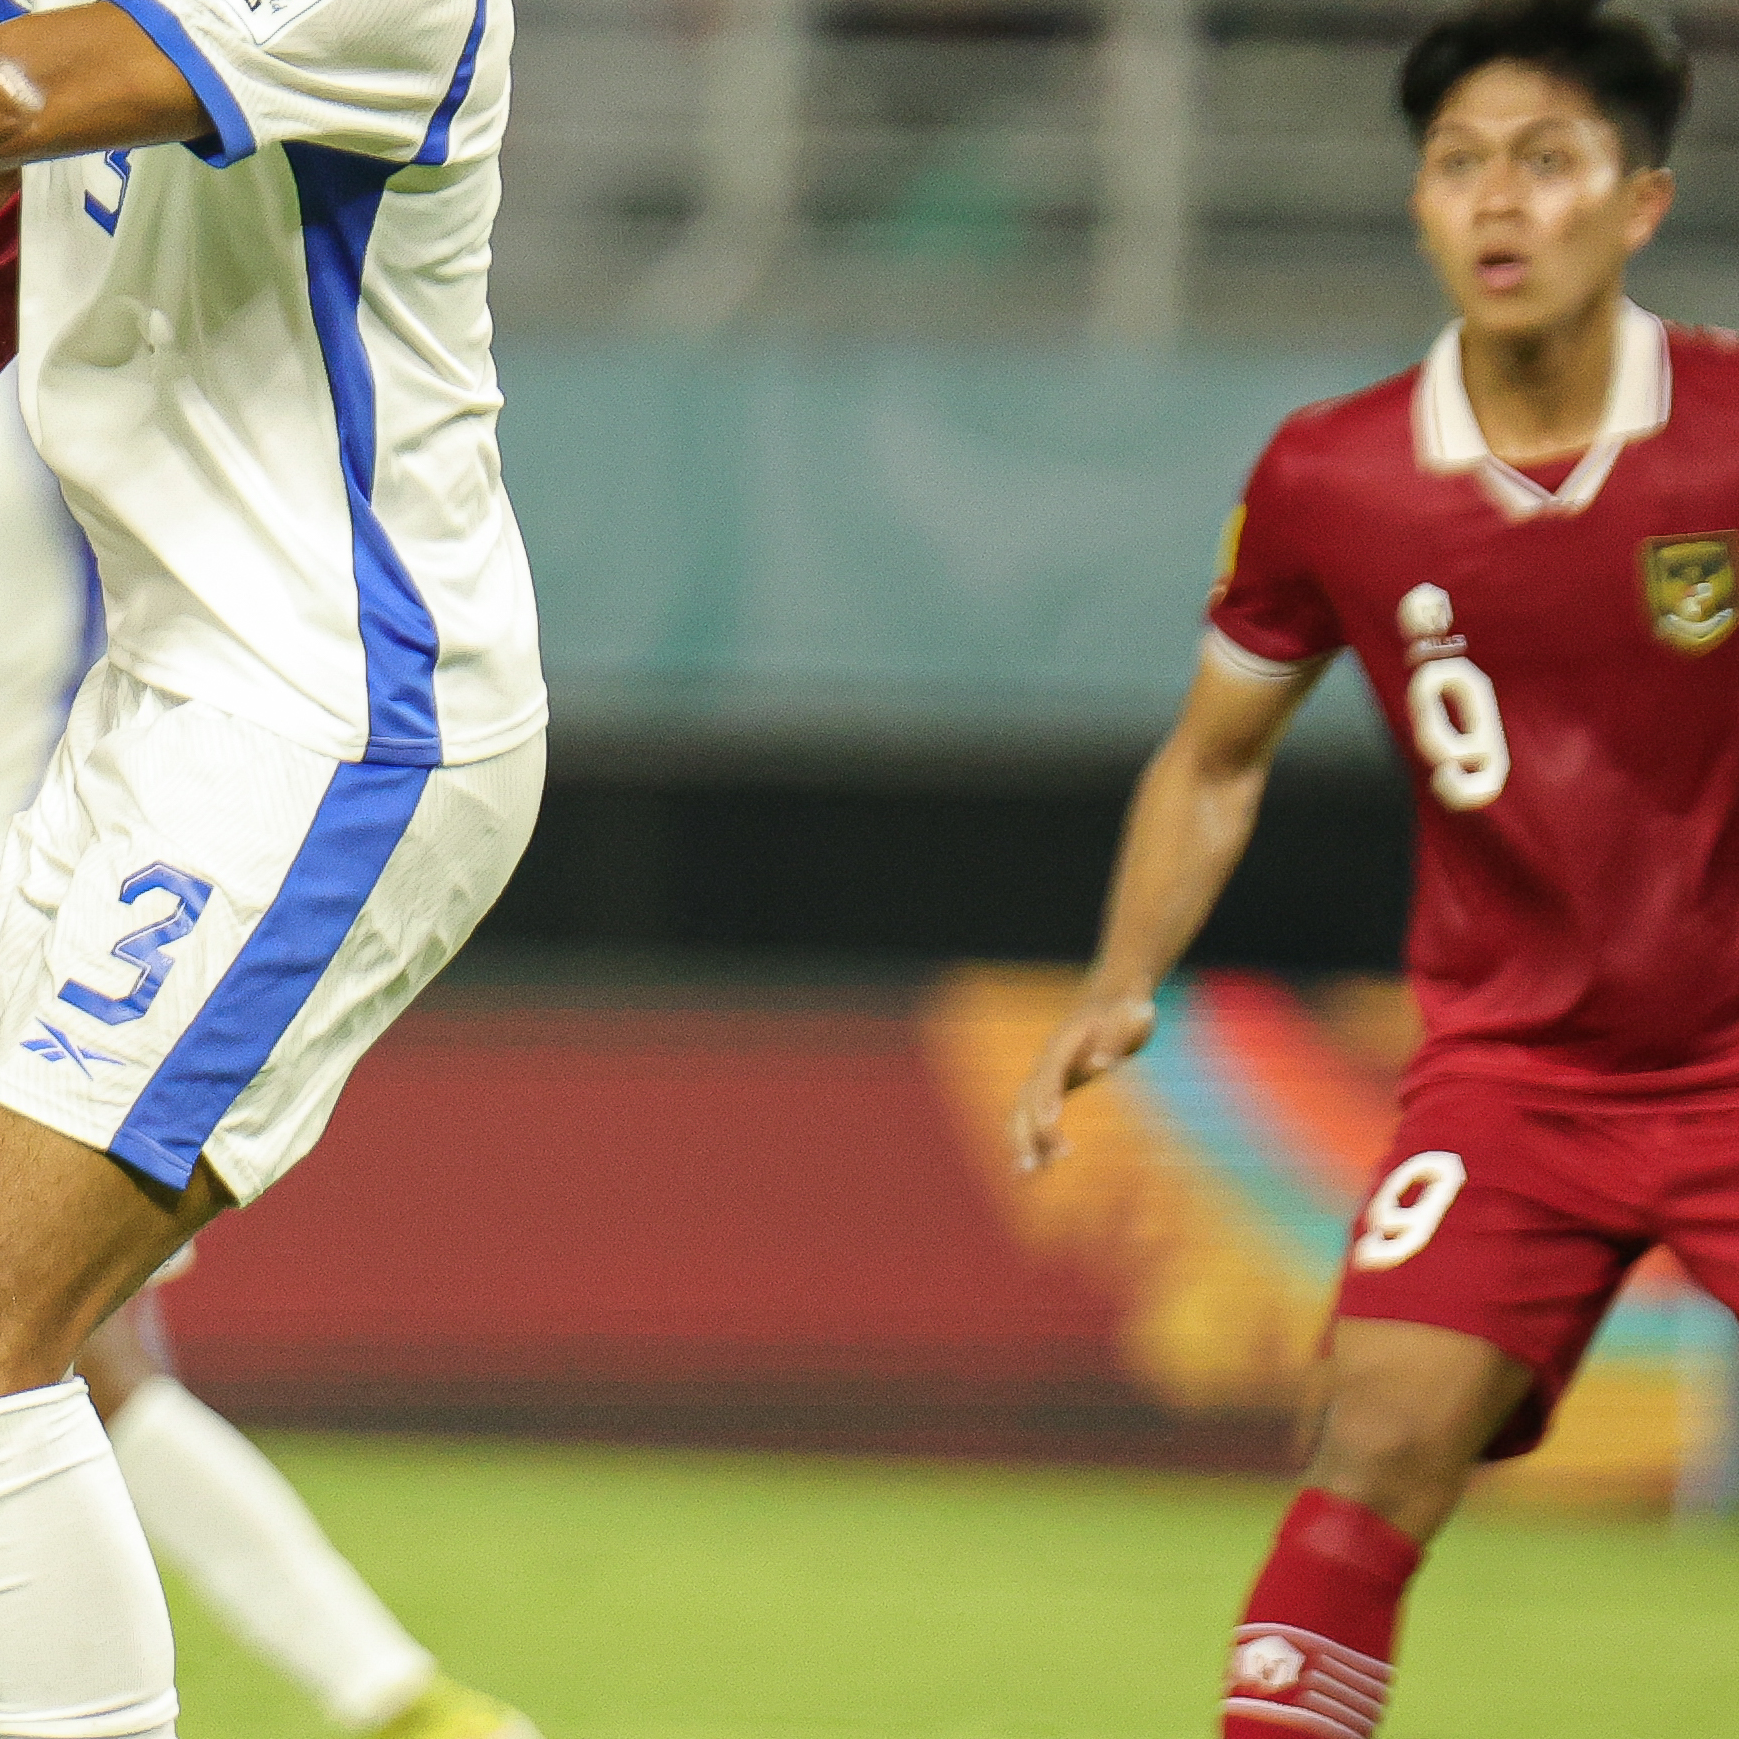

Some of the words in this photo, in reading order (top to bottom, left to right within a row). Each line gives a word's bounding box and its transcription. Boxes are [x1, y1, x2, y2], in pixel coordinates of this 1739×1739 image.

[1407, 656, 1511, 812] 9
[57, 861, 214, 1025] 3
[1353, 1150, 1469, 1272] 9
